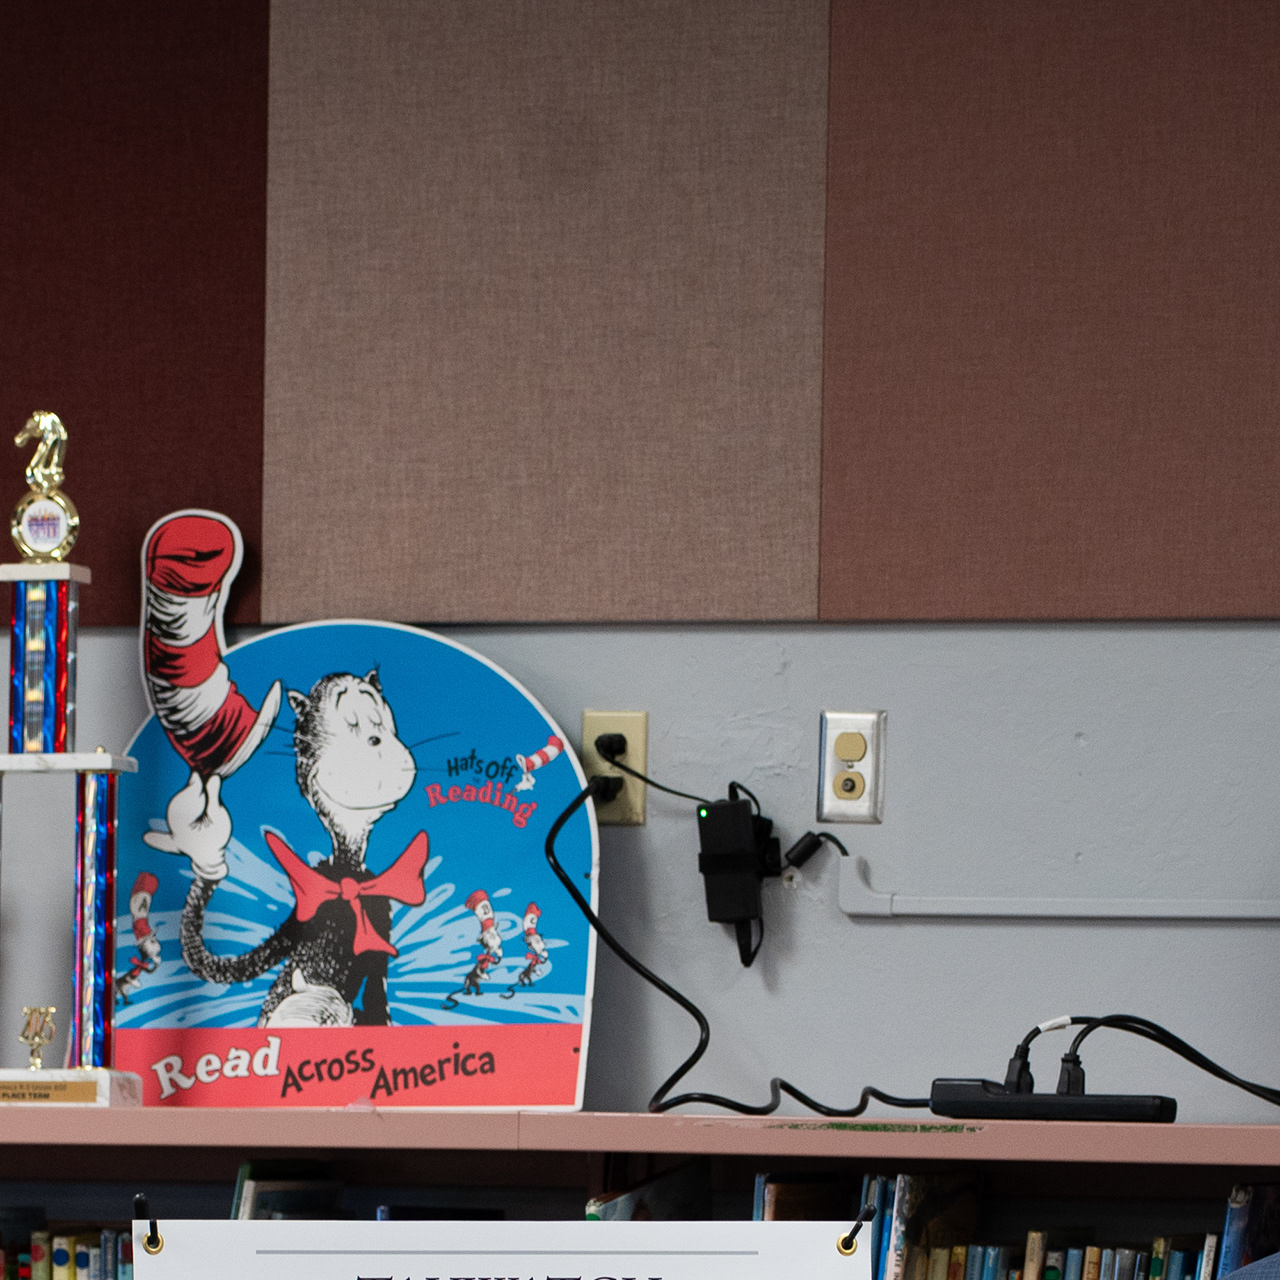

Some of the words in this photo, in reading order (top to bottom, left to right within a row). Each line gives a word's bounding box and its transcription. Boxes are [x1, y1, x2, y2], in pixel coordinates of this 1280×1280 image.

[447, 749, 484, 778] Hats
[485, 757, 519, 783] Off
[424, 780, 538, 828] Reading
[151, 1035, 282, 1100] Read
[278, 1048, 376, 1098] Across
[369, 1042, 497, 1101] America
